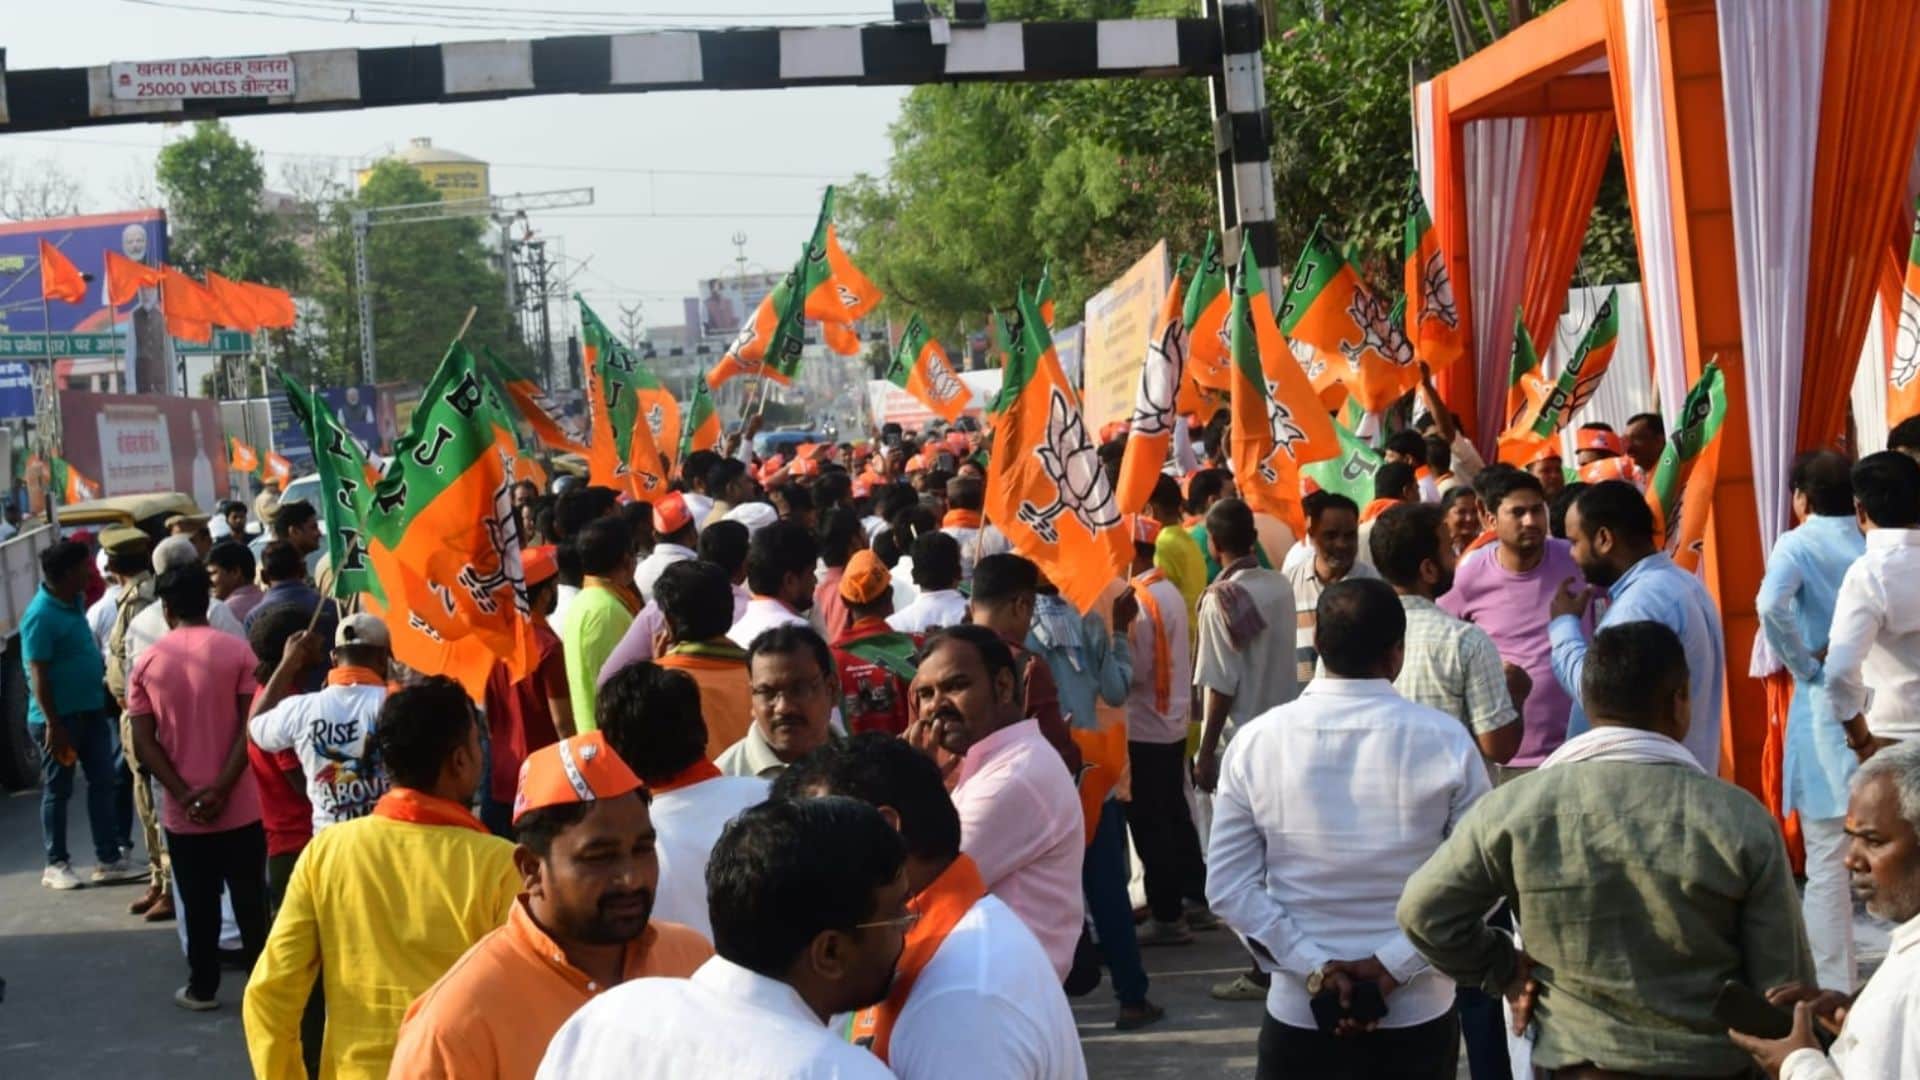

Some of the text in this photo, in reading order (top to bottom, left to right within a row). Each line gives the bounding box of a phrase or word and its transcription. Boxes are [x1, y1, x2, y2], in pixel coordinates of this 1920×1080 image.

[136, 59, 289, 77] खतरा DANGER खतरा
[137, 81, 187, 97] 25000
[190, 80, 237, 96] VOLTS
[309, 718, 360, 747] RISE
